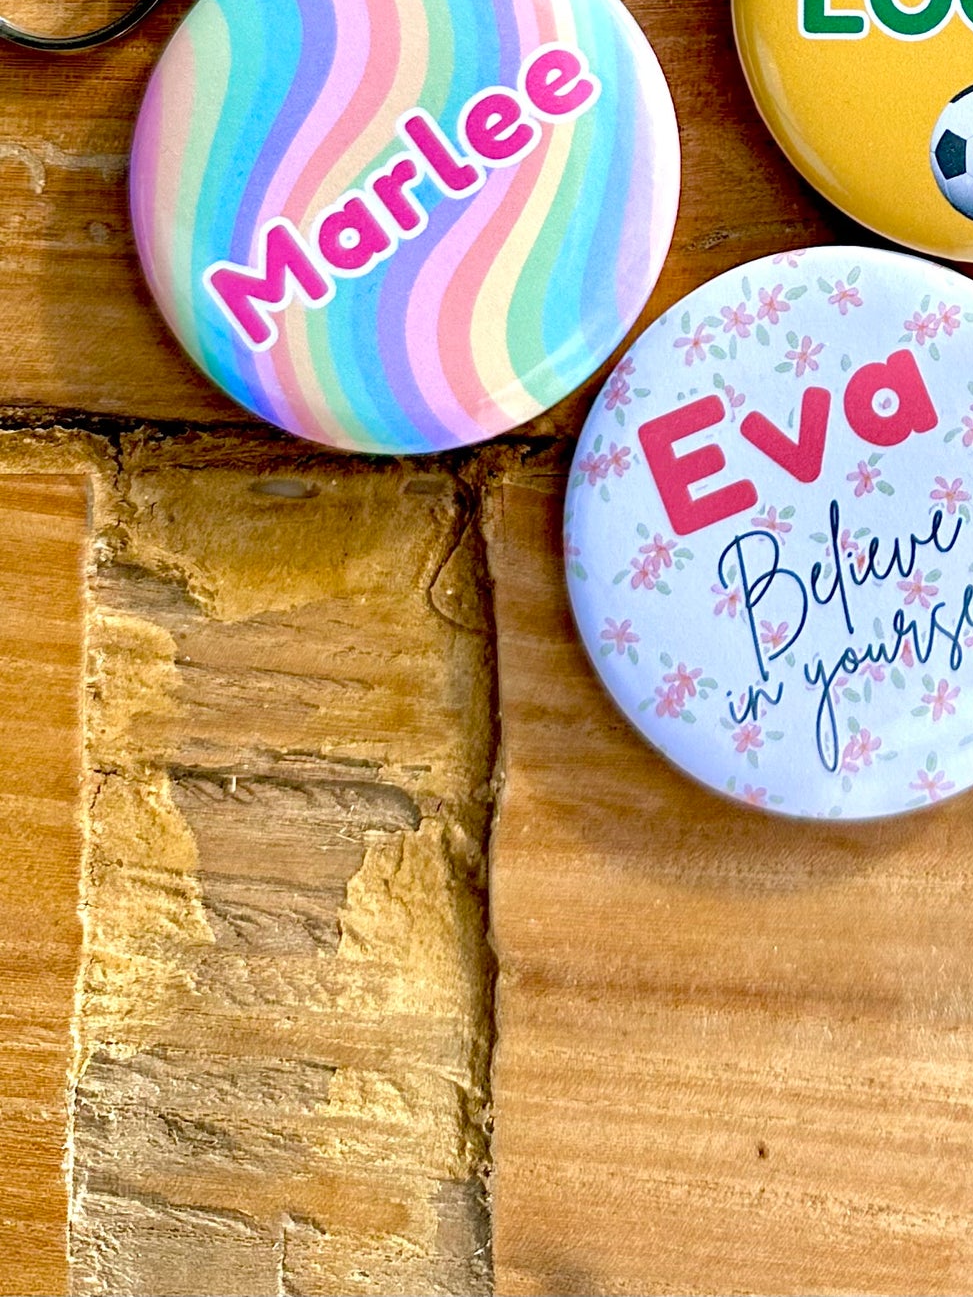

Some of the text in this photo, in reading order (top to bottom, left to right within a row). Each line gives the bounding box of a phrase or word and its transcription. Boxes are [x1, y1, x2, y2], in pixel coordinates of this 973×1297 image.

[203, 41, 602, 352] Marlee
[637, 348, 939, 536] Eva
[718, 500, 963, 681] Believe
[725, 681, 783, 725] in
